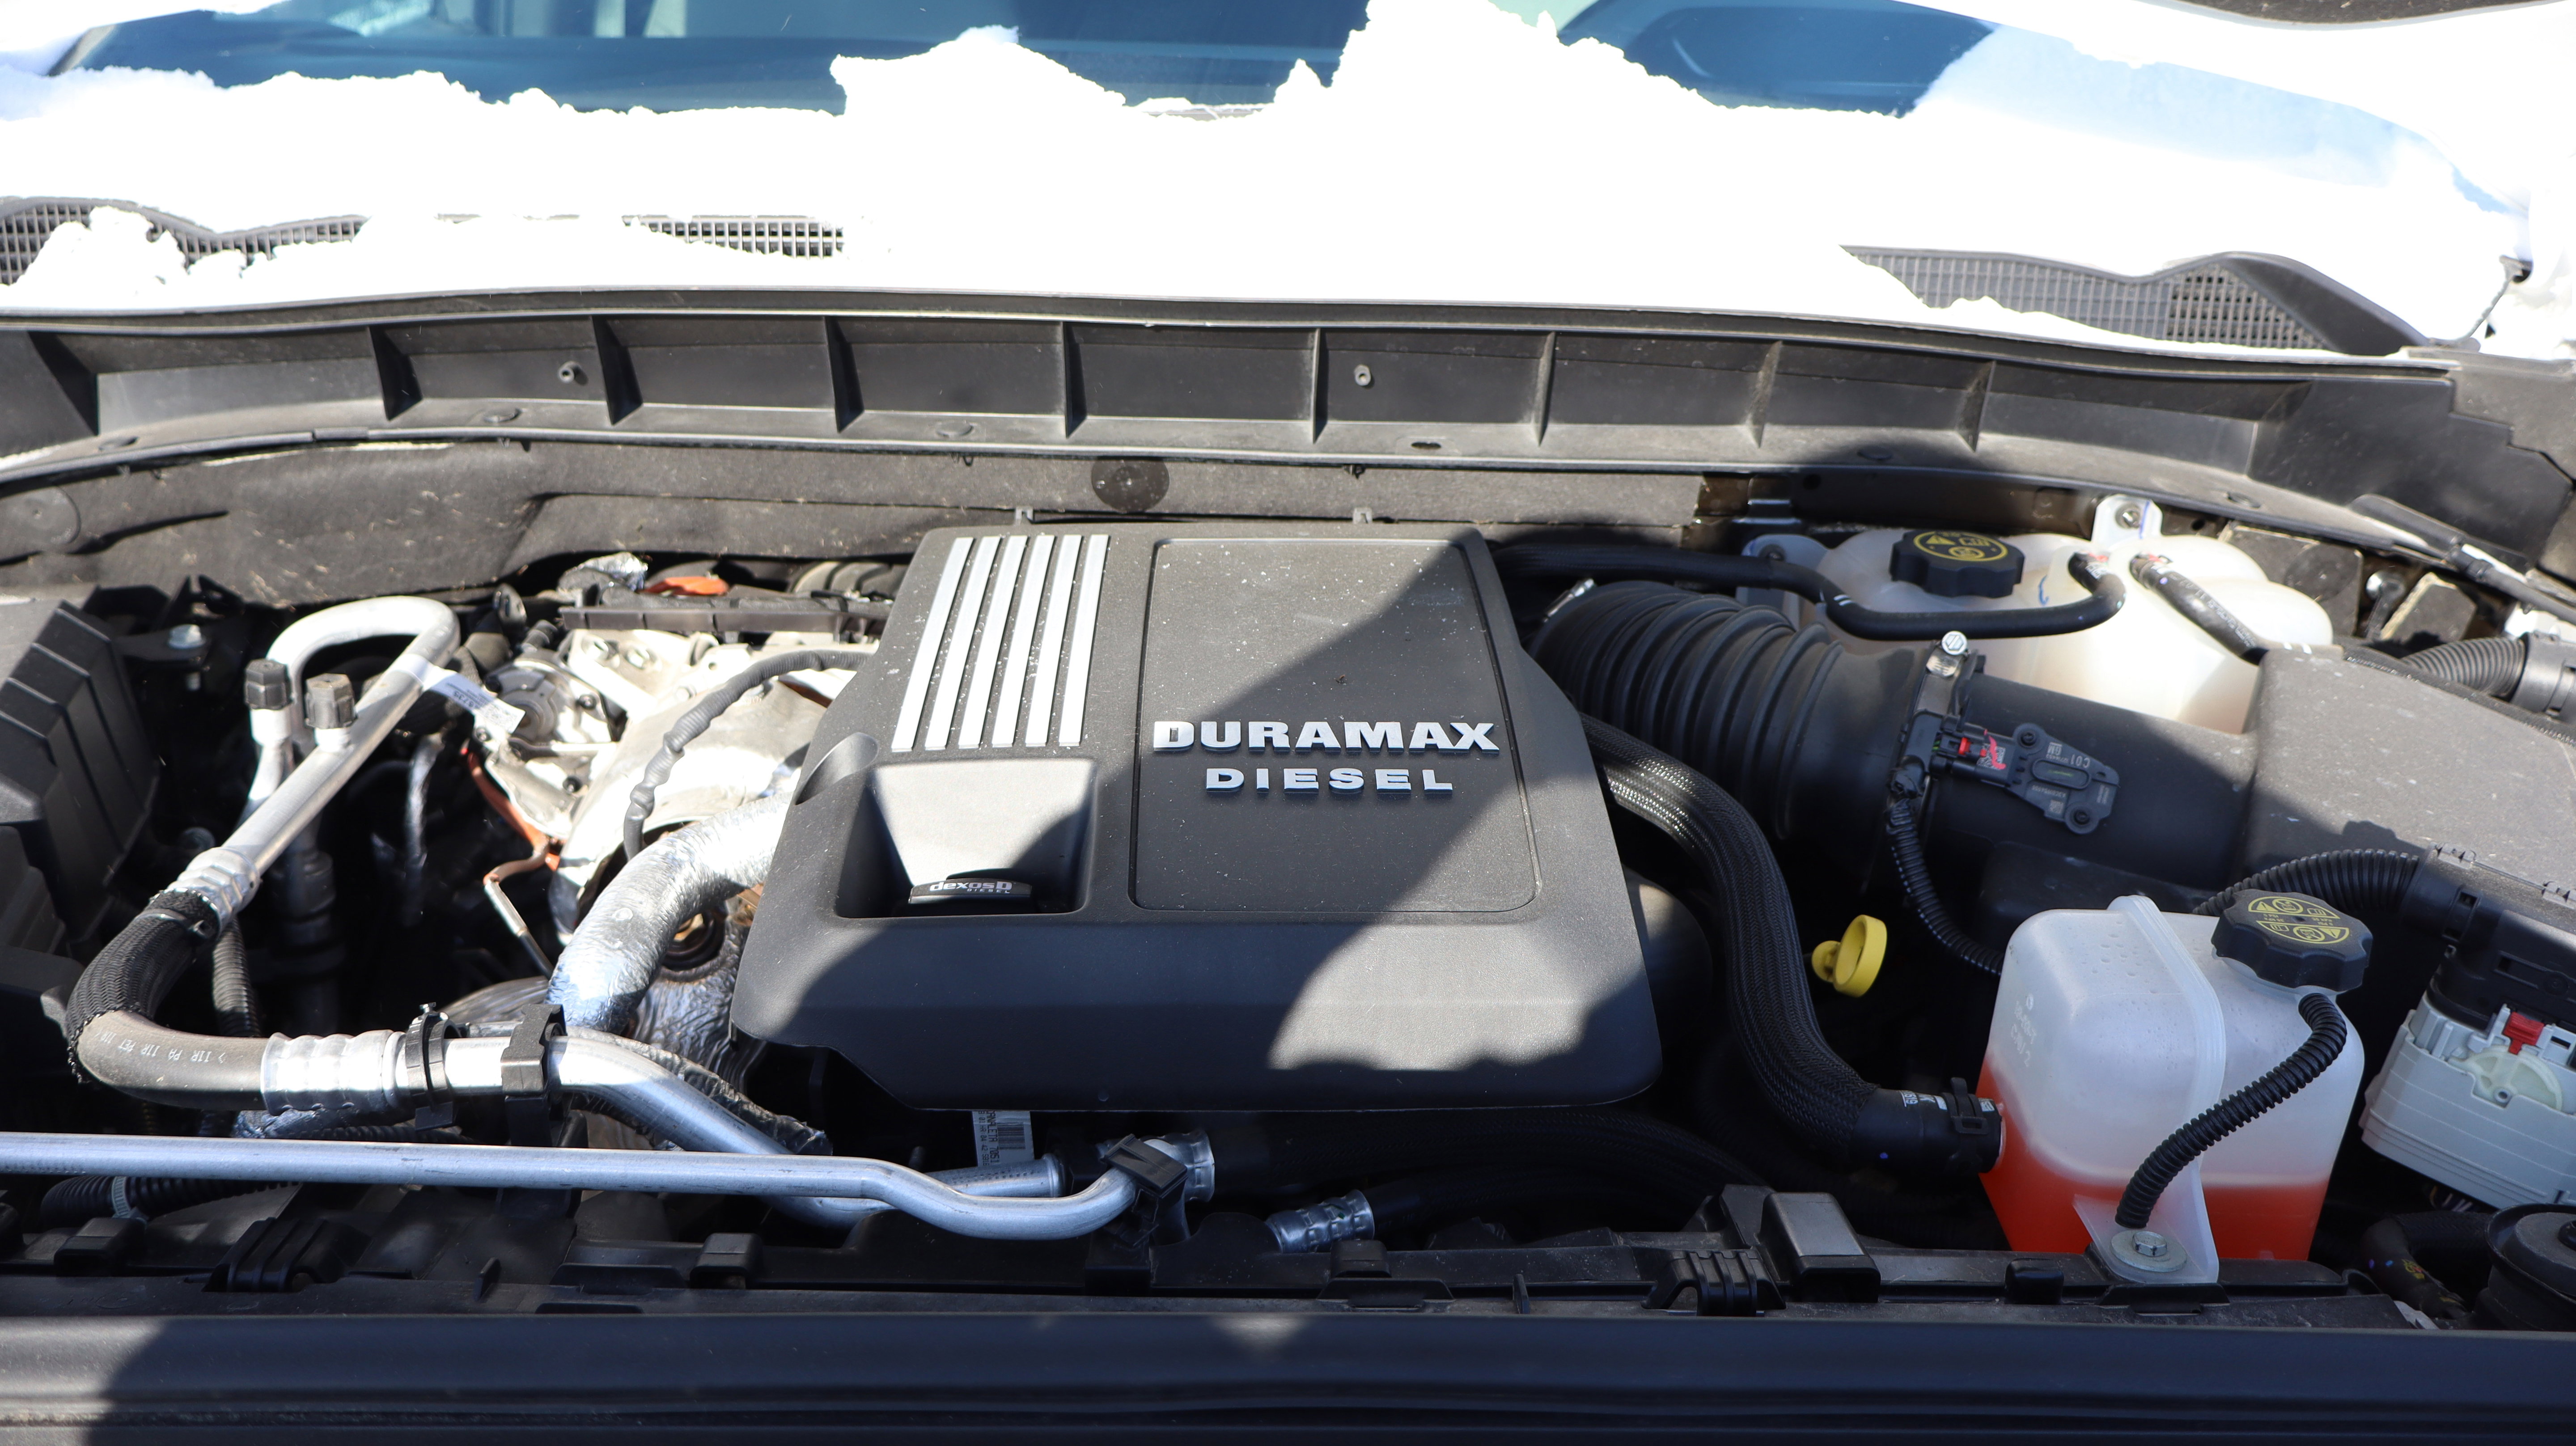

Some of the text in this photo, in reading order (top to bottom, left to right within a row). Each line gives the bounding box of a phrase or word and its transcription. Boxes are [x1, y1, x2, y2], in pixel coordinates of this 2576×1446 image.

[1152, 721, 1500, 753] DURAMAX
[1206, 768, 1453, 793] DIESEL
[118, 1038, 137, 1052] PET
[168, 1048, 183, 1061] PA
